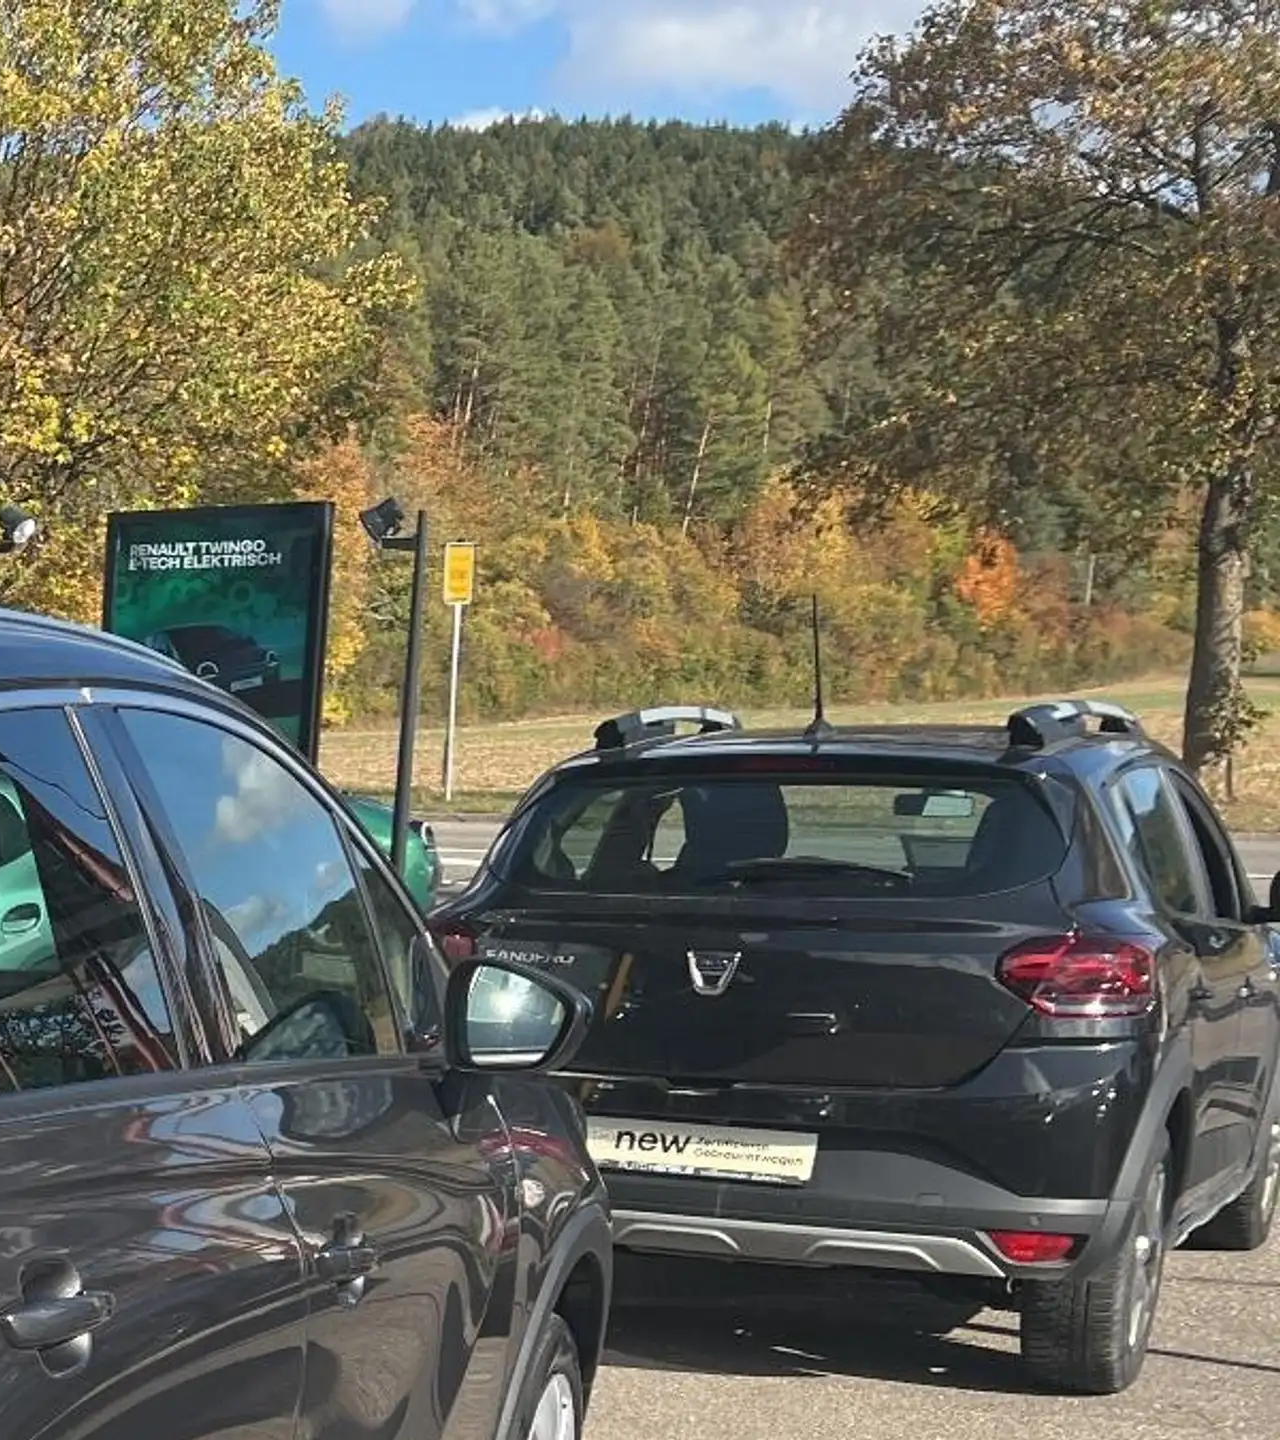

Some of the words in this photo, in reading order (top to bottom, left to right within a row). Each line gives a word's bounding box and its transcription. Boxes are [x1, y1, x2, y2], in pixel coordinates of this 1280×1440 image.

[130, 542, 197, 557] RENAULT
[199, 539, 266, 553] TWINGO
[128, 556, 181, 571] E-TECH
[183, 552, 282, 569] ELEKTRISCH
